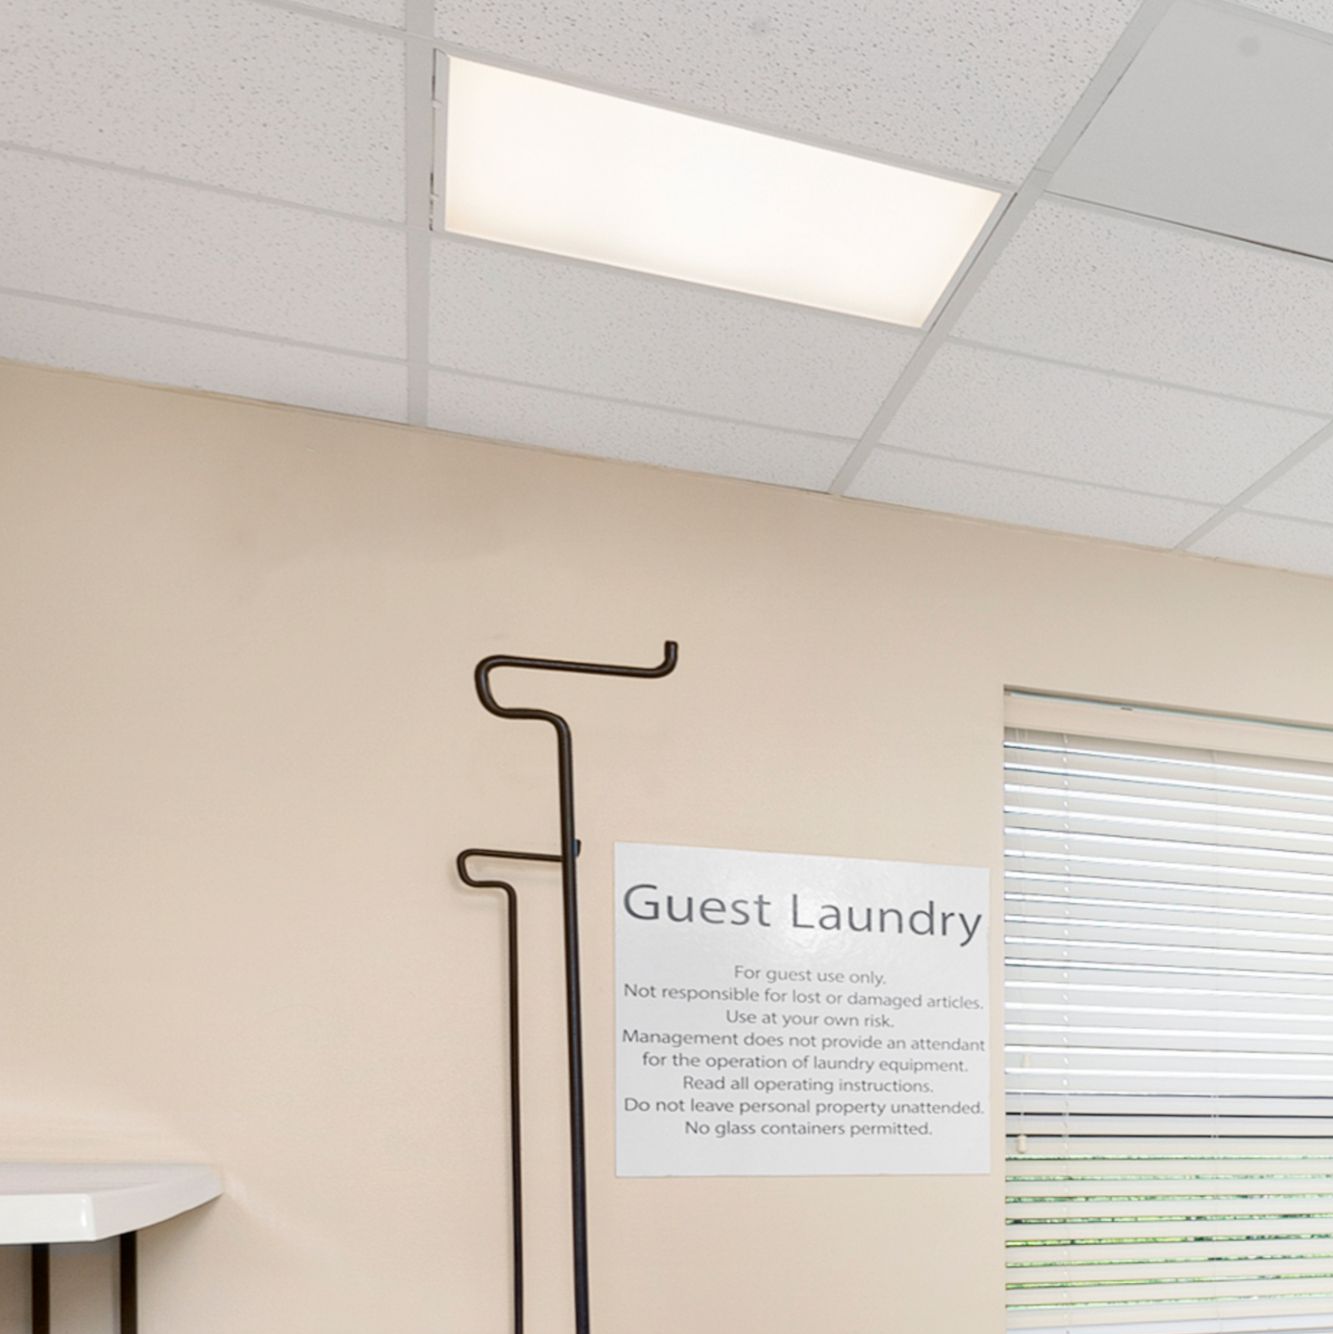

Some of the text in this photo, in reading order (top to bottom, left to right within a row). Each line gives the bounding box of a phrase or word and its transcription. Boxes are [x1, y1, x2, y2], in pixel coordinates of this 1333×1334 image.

[622, 883, 983, 948] Guest Laundry
[734, 964, 886, 988] For guest use only.
[623, 982, 984, 1010] Not responsible for lost or damaged articles.
[726, 1009, 894, 1028] Use at your own risk.
[621, 1028, 985, 1052] Management does not provide an attendant
[642, 1050, 968, 1074] for the operation of laundry equipment.
[683, 1075, 934, 1095] Read all operating instructions.
[623, 1097, 984, 1117] Do not leave personal property unattended.
[684, 1120, 933, 1139] No glass containers permitted.
